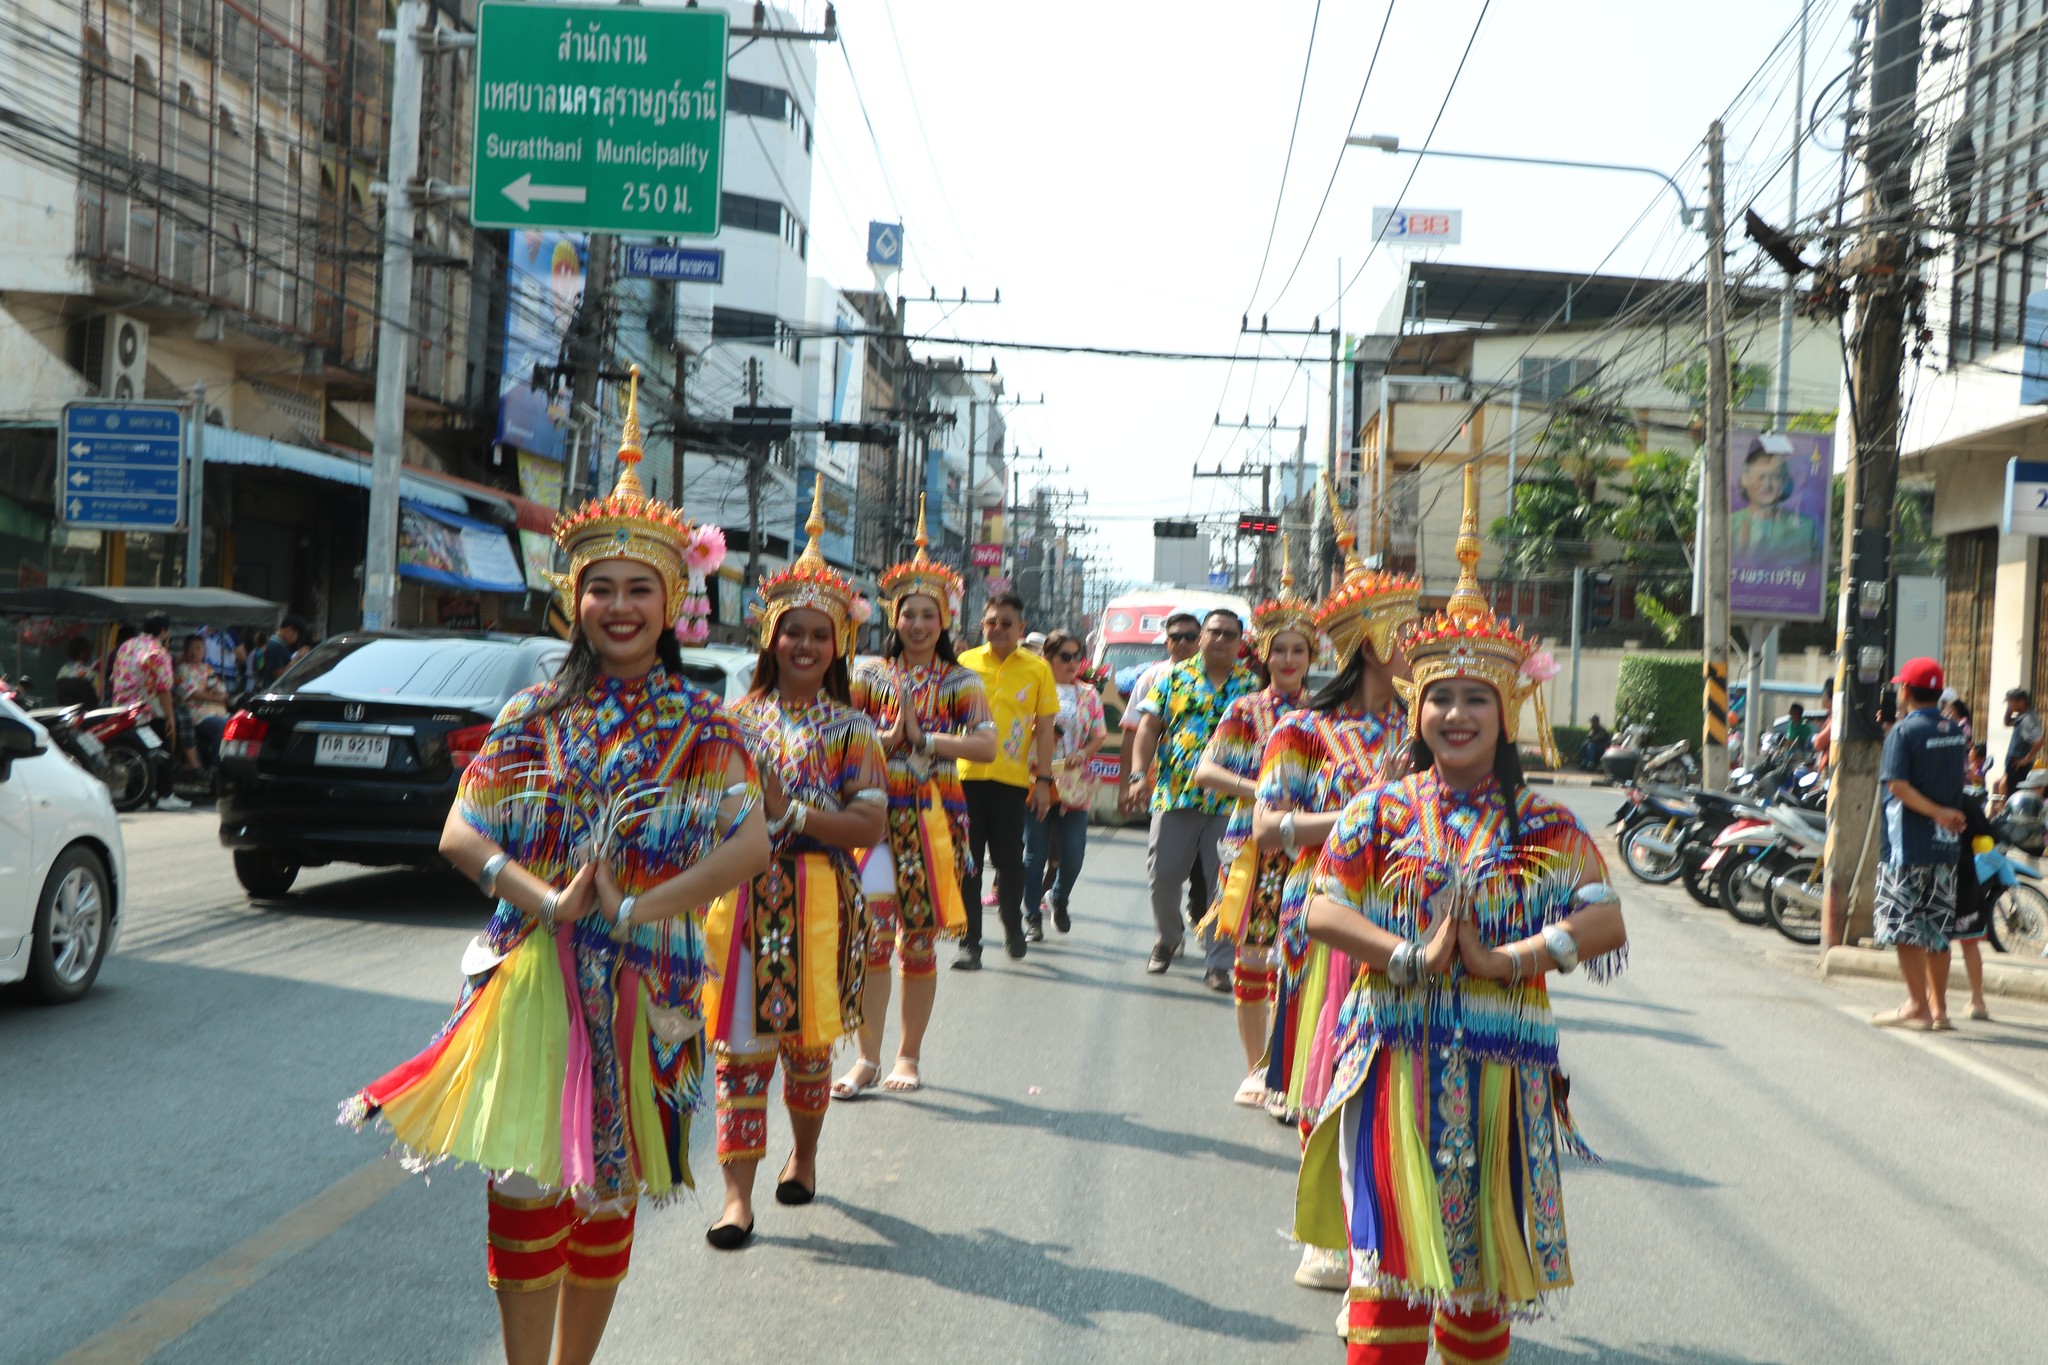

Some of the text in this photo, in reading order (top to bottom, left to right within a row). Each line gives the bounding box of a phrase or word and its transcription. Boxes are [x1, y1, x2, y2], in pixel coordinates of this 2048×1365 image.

[558, 18, 647, 65] สำนักงาน
[484, 78, 717, 128] เทศบาลนครสุราษฎร์ธานี
[486, 133, 709, 174] Suratthani Municipality
[1385, 210, 1450, 238] 3BB
